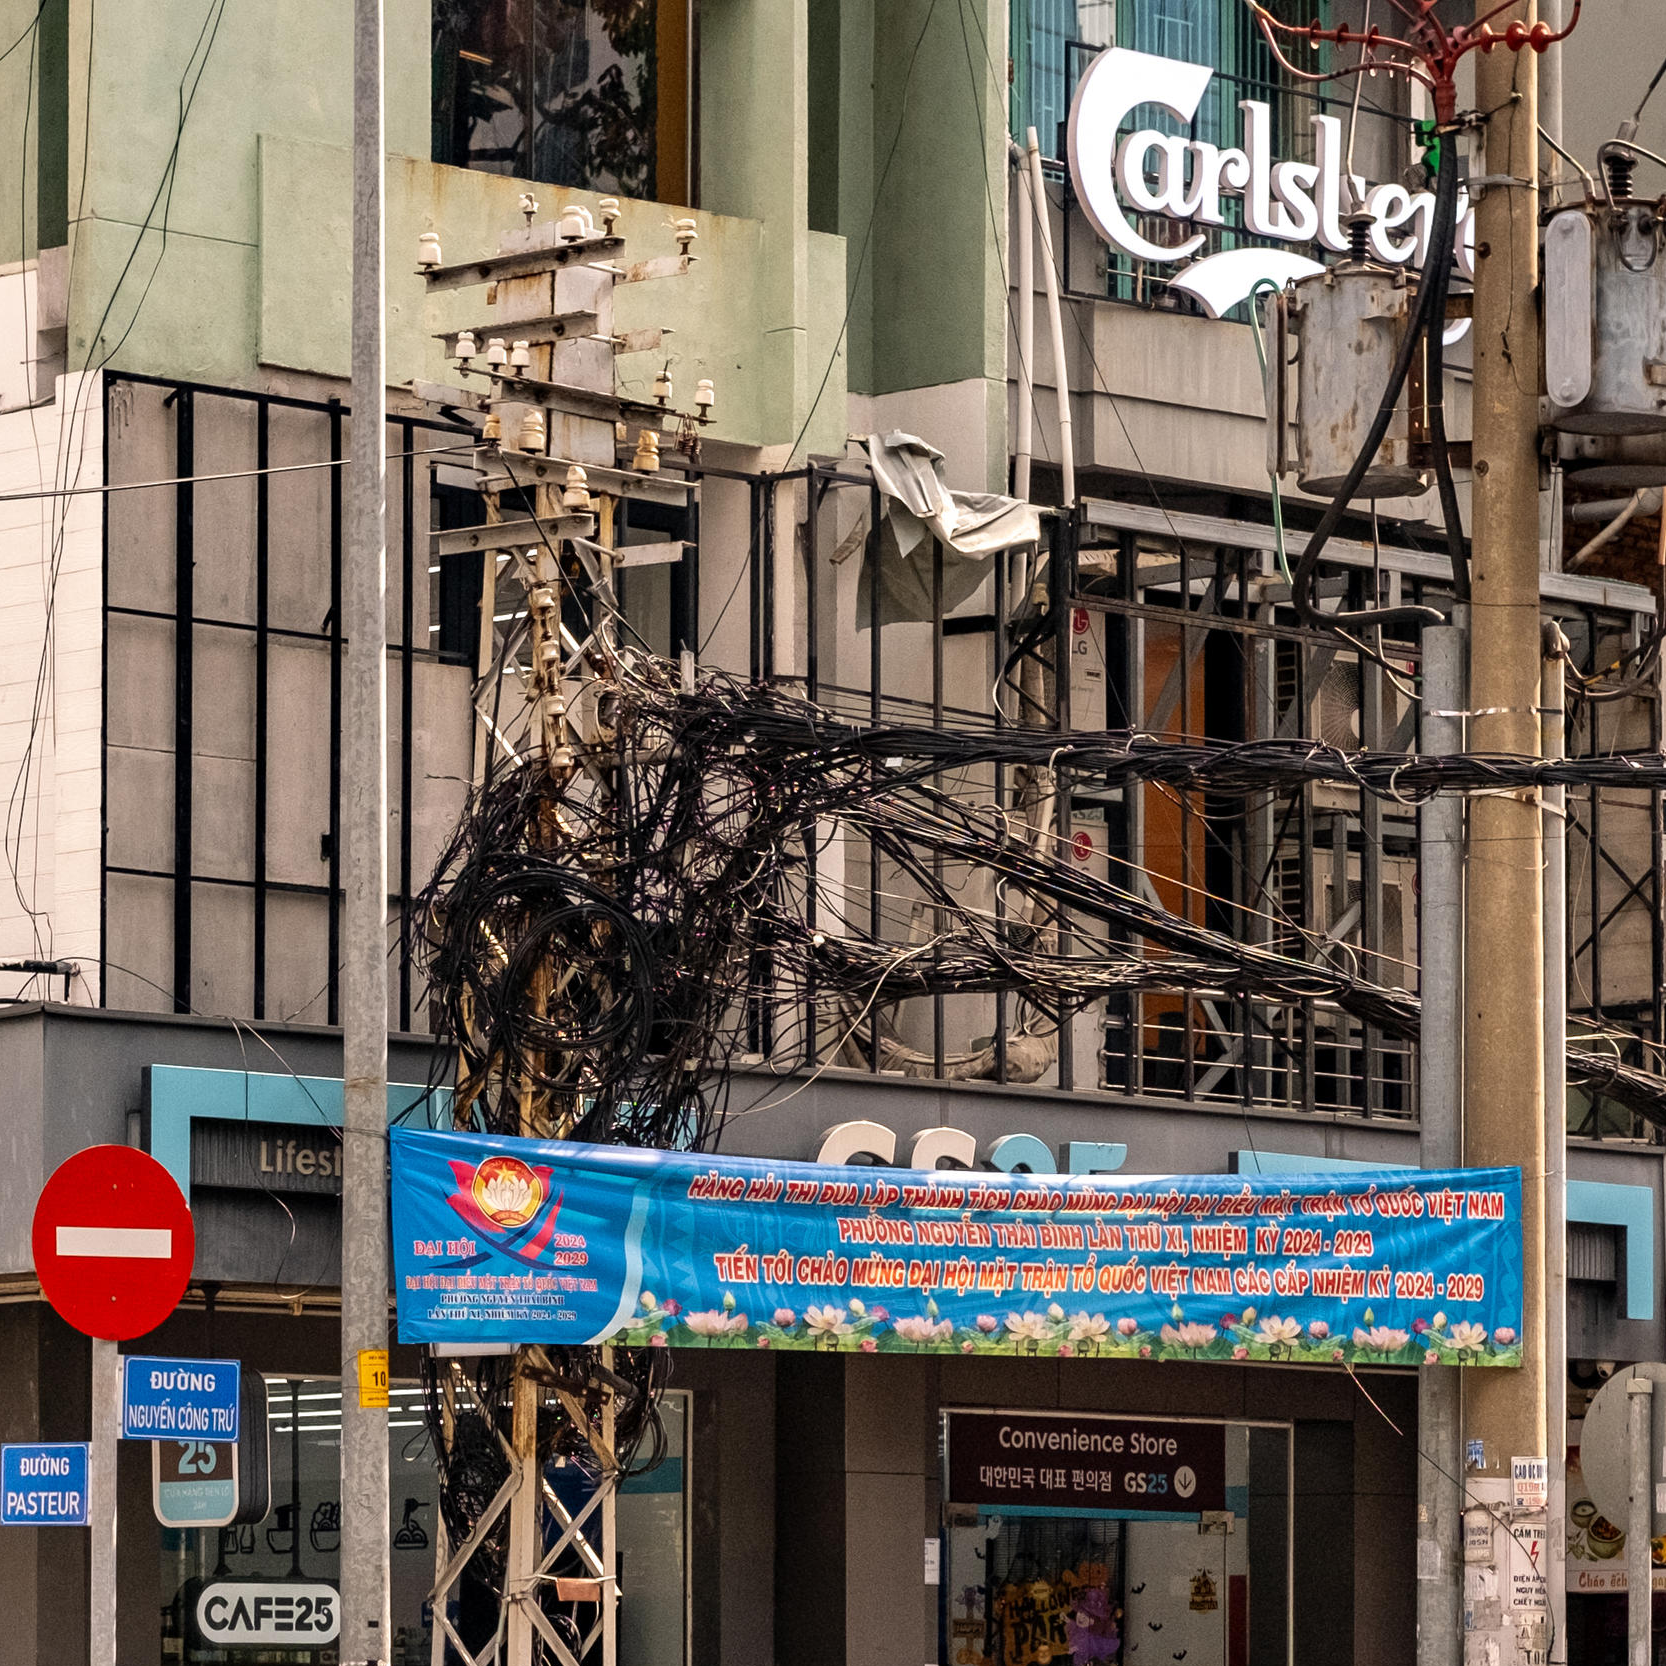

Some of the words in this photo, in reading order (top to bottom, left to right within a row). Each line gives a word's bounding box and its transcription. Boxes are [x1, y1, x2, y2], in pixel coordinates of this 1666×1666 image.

[749, 1173, 781, 1202] HÁI
[787, 1178, 818, 1203] THI
[1375, 1186, 1424, 1219] QUỐC
[1425, 1188, 1466, 1225] VIỆT
[1467, 1190, 1505, 1220] NAM
[413, 1239, 443, 1257] ĐẠI
[446, 1236, 477, 1260] HỘI
[553, 1233, 587, 1248] 2024
[1039, 1220, 1084, 1250] BÌNH
[1192, 1221, 1247, 1259] NHIỆM
[1283, 1229, 1322, 1257] 2024
[1334, 1230, 1375, 1258] 2029
[553, 1251, 589, 1267] 2029
[714, 1243, 759, 1284] TIẾN
[760, 1249, 794, 1285] TỚI
[796, 1251, 848, 1287] CHÀO
[851, 1252, 906, 1288] MỪNG
[907, 1259, 941, 1295] ĐẠI
[943, 1255, 977, 1297] HỘI
[1020, 1258, 1069, 1298] TRẬN
[1072, 1251, 1097, 1291] TỔ
[1097, 1256, 1147, 1293] QUỐC
[1150, 1260, 1191, 1300] VIỆT
[1192, 1266, 1232, 1295] NAM
[1235, 1261, 1272, 1296] CÁC
[1274, 1259, 1310, 1297] CẤP
[1312, 1264, 1365, 1304] NHIỆM
[1395, 1272, 1435, 1300] 2024
[1446, 1273, 1485, 1302] 2029
[149, 1369, 216, 1393] ĐƯỜNG
[371, 1371, 387, 1388] 10
[128, 1397, 176, 1431] NGUYỄN
[177, 1400, 210, 1432] CÔNG
[211, 1402, 234, 1433] TRỨ
[998, 1426, 1125, 1454] Convenience
[1129, 1431, 1178, 1456] Store
[19, 1452, 71, 1477] ĐƯỜNG
[177, 1441, 218, 1475] 25
[979, 1465, 1035, 1489] 대한민국
[1039, 1467, 1067, 1490] 대표
[1071, 1469, 1112, 1493] 편의점
[1123, 1472, 1169, 1495] GS25
[6, 1491, 81, 1517] PASTEUR
[1578, 1570, 1605, 1588] Cháo
[203, 1595, 334, 1632] CAFE25
